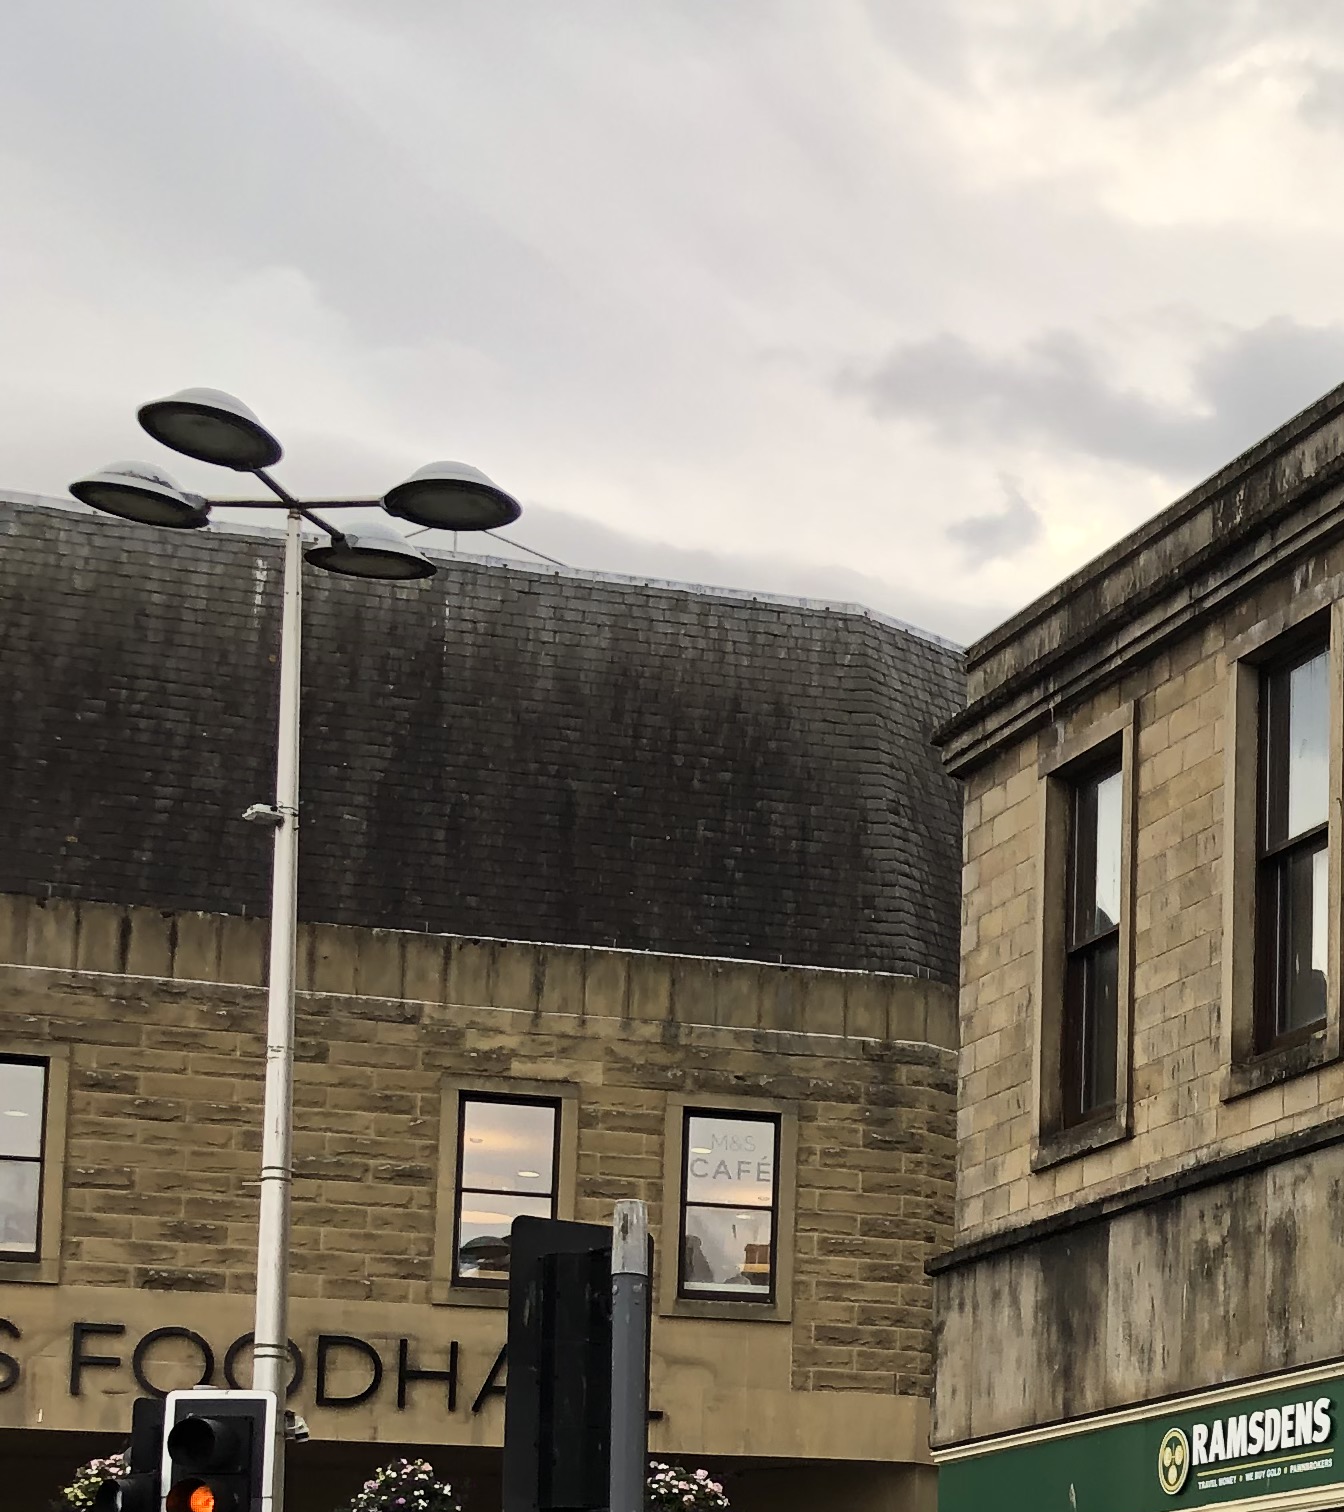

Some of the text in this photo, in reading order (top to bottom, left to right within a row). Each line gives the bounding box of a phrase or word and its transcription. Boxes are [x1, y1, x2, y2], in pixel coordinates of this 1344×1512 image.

[711, 1133, 756, 1153] M&S
[690, 1156, 771, 1183] CAFÉ
[1192, 1397, 1332, 1466] RAMSDENS
